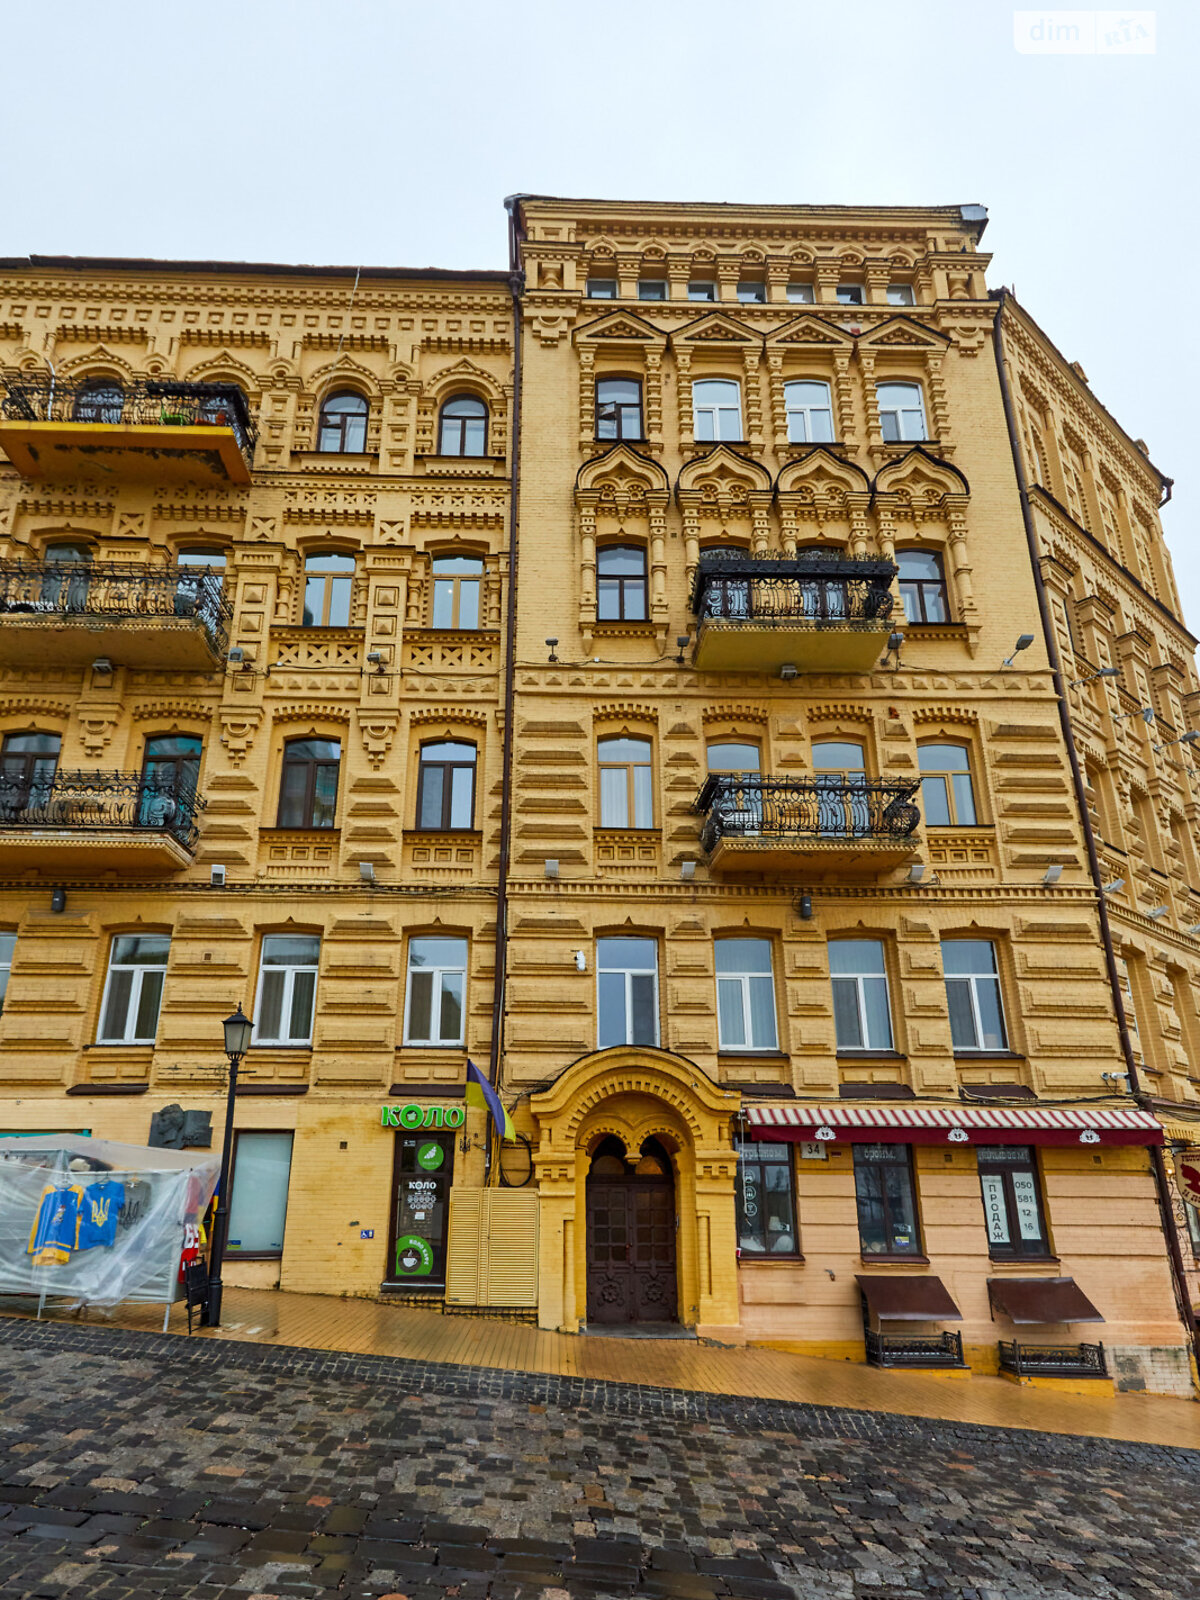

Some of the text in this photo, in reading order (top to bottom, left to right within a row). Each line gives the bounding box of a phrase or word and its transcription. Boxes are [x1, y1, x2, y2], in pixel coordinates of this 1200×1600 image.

[381, 1104, 465, 1129] КОЛО
[807, 1144, 820, 1154] 34
[408, 1181, 437, 1190] КОЛО
[1015, 1181, 1032, 1189] 050
[1017, 1195, 1033, 1203] 581
[988, 1184, 1004, 1240] ПРОДАЖ
[1022, 1209, 1031, 1217] 12
[1024, 1223, 1034, 1231] 16
